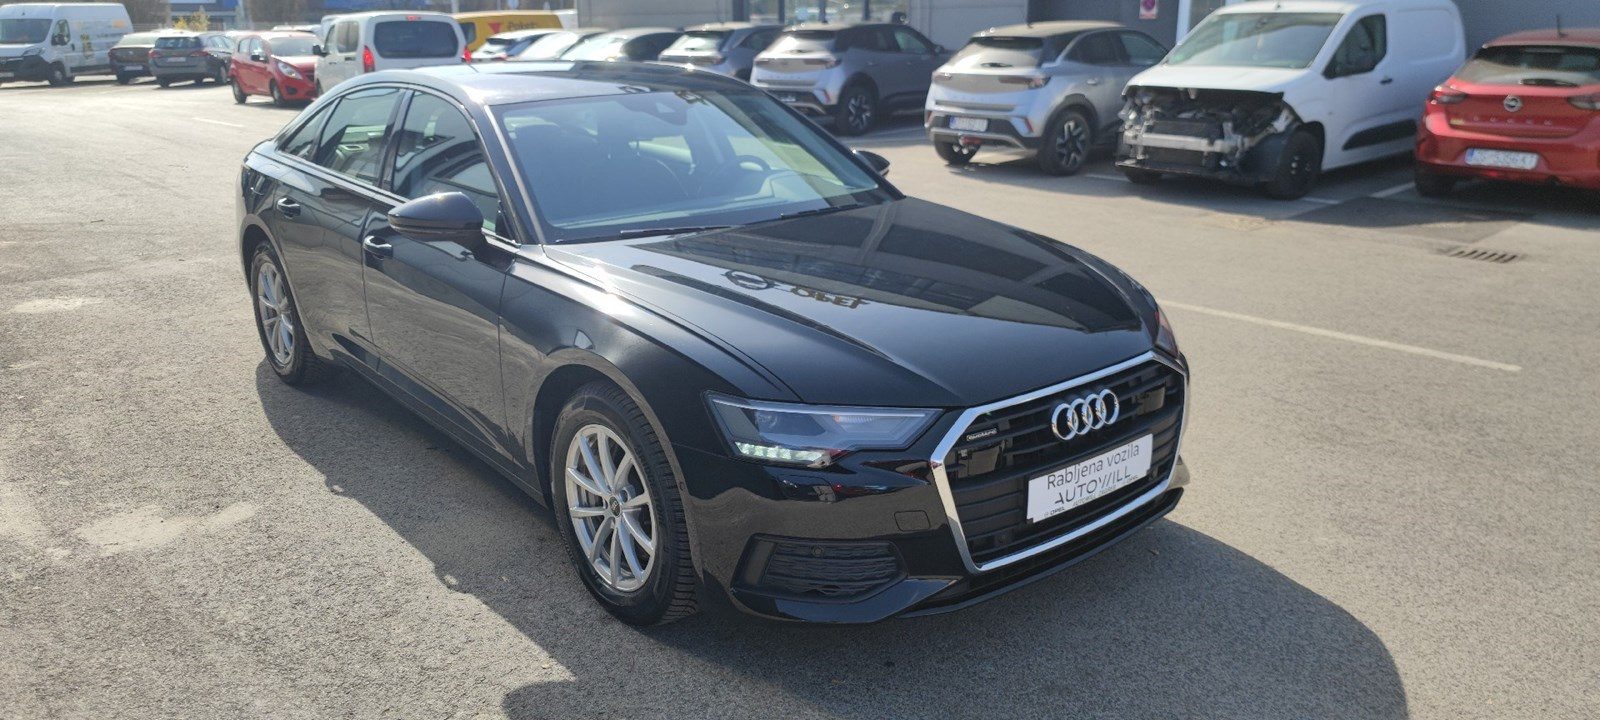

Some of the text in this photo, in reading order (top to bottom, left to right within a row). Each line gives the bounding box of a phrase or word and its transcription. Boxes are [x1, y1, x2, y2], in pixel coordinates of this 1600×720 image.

[1046, 460, 1103, 490] Rabljena
[1106, 444, 1140, 467] vozila
[1054, 466, 1131, 505] AUTOWILL
